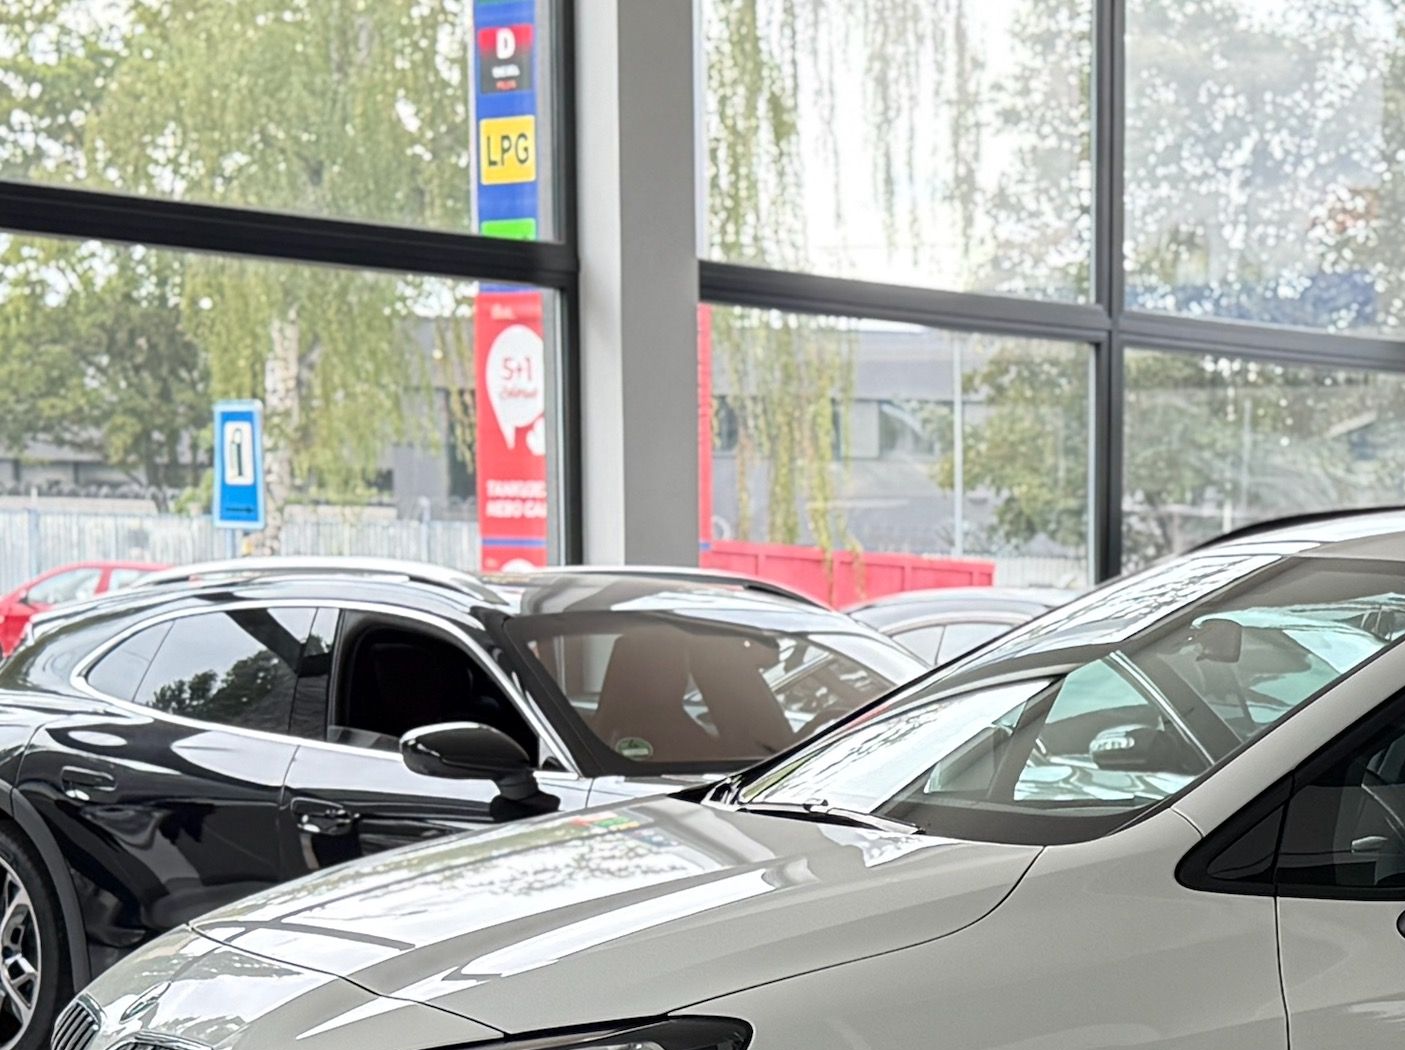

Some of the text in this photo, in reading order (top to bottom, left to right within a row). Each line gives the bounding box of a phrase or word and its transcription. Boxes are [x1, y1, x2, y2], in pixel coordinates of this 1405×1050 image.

[496, 27, 516, 59] D
[486, 132, 530, 167] LPG
[501, 355, 533, 382] 5+1
